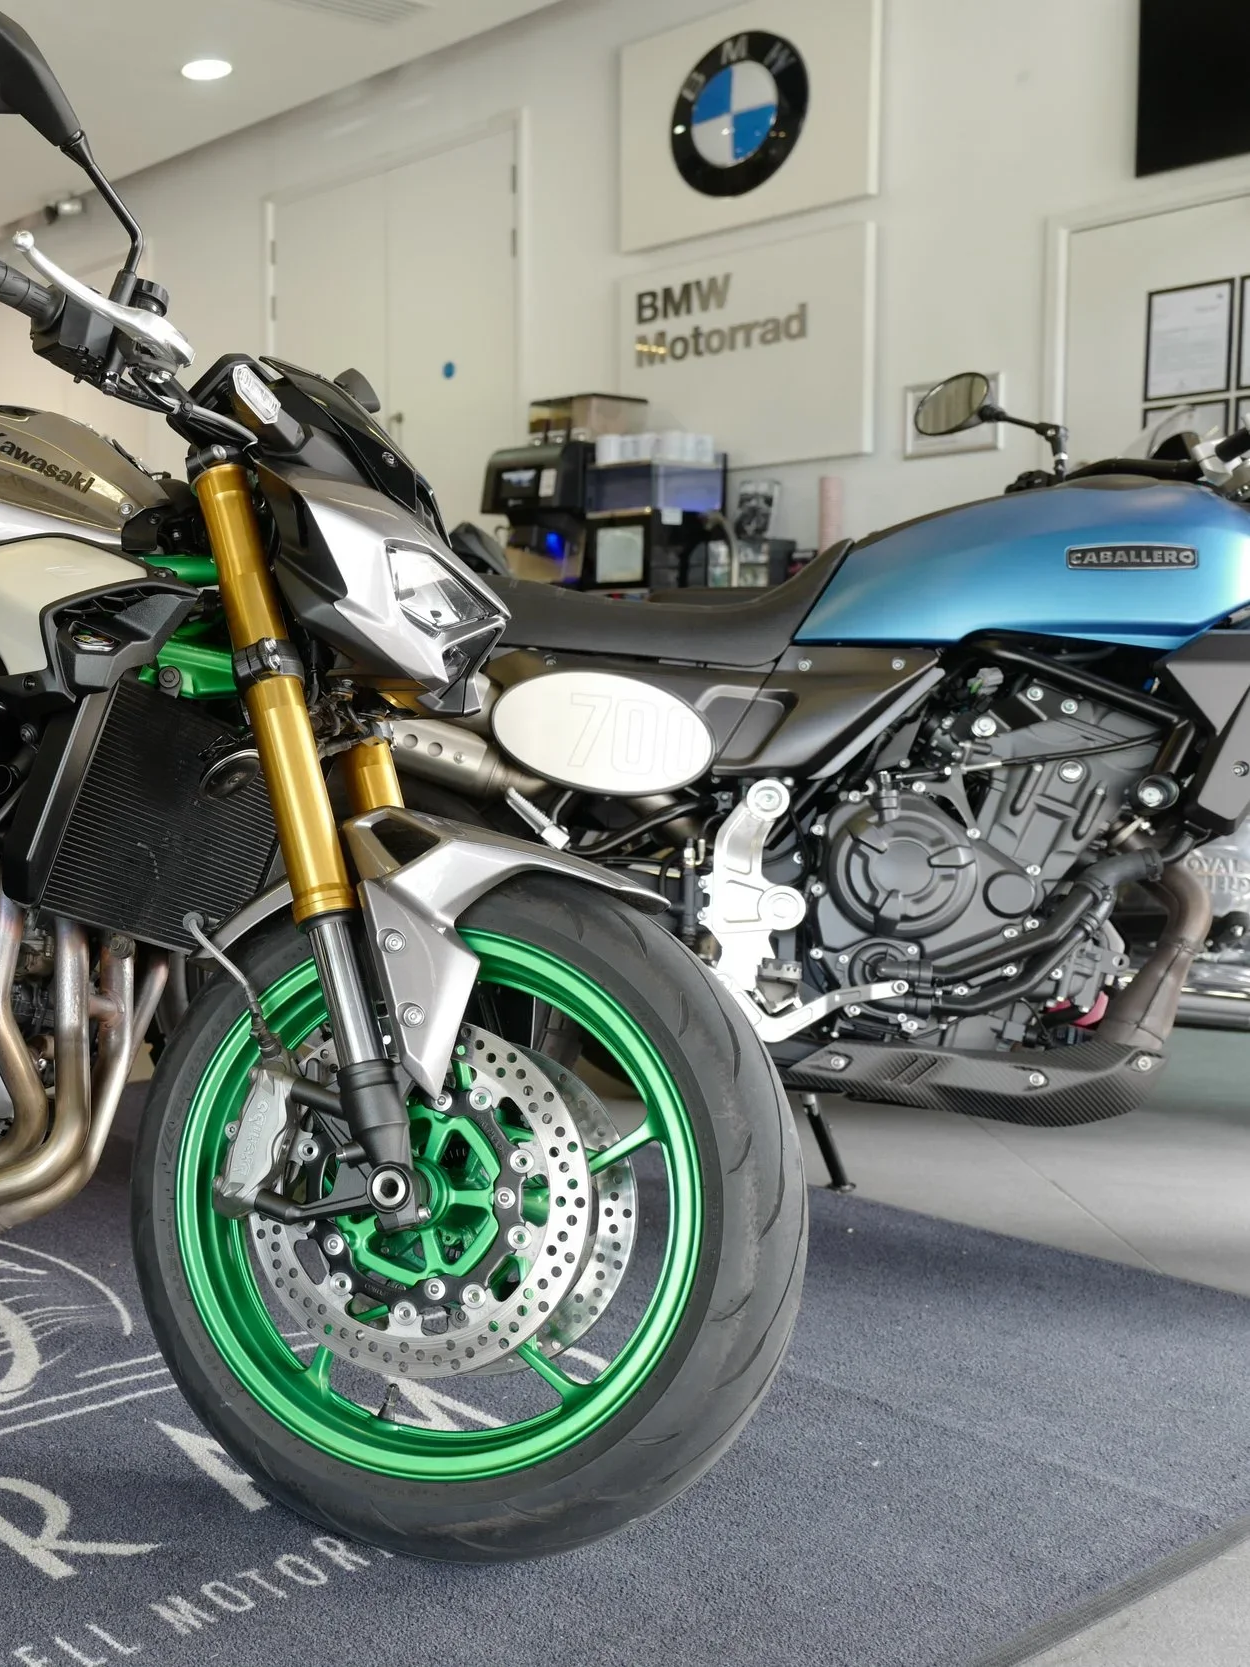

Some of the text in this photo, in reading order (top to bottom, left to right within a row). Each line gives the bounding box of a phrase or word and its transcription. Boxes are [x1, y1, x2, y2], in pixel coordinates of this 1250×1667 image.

[681, 34, 798, 102] BMW
[636, 272, 732, 325] BMW
[634, 302, 808, 368] Motorrad
[1070, 550, 1195, 565] CABALLERO
[567, 692, 708, 782] 700
[150, 1537, 394, 1635] MOTOR
